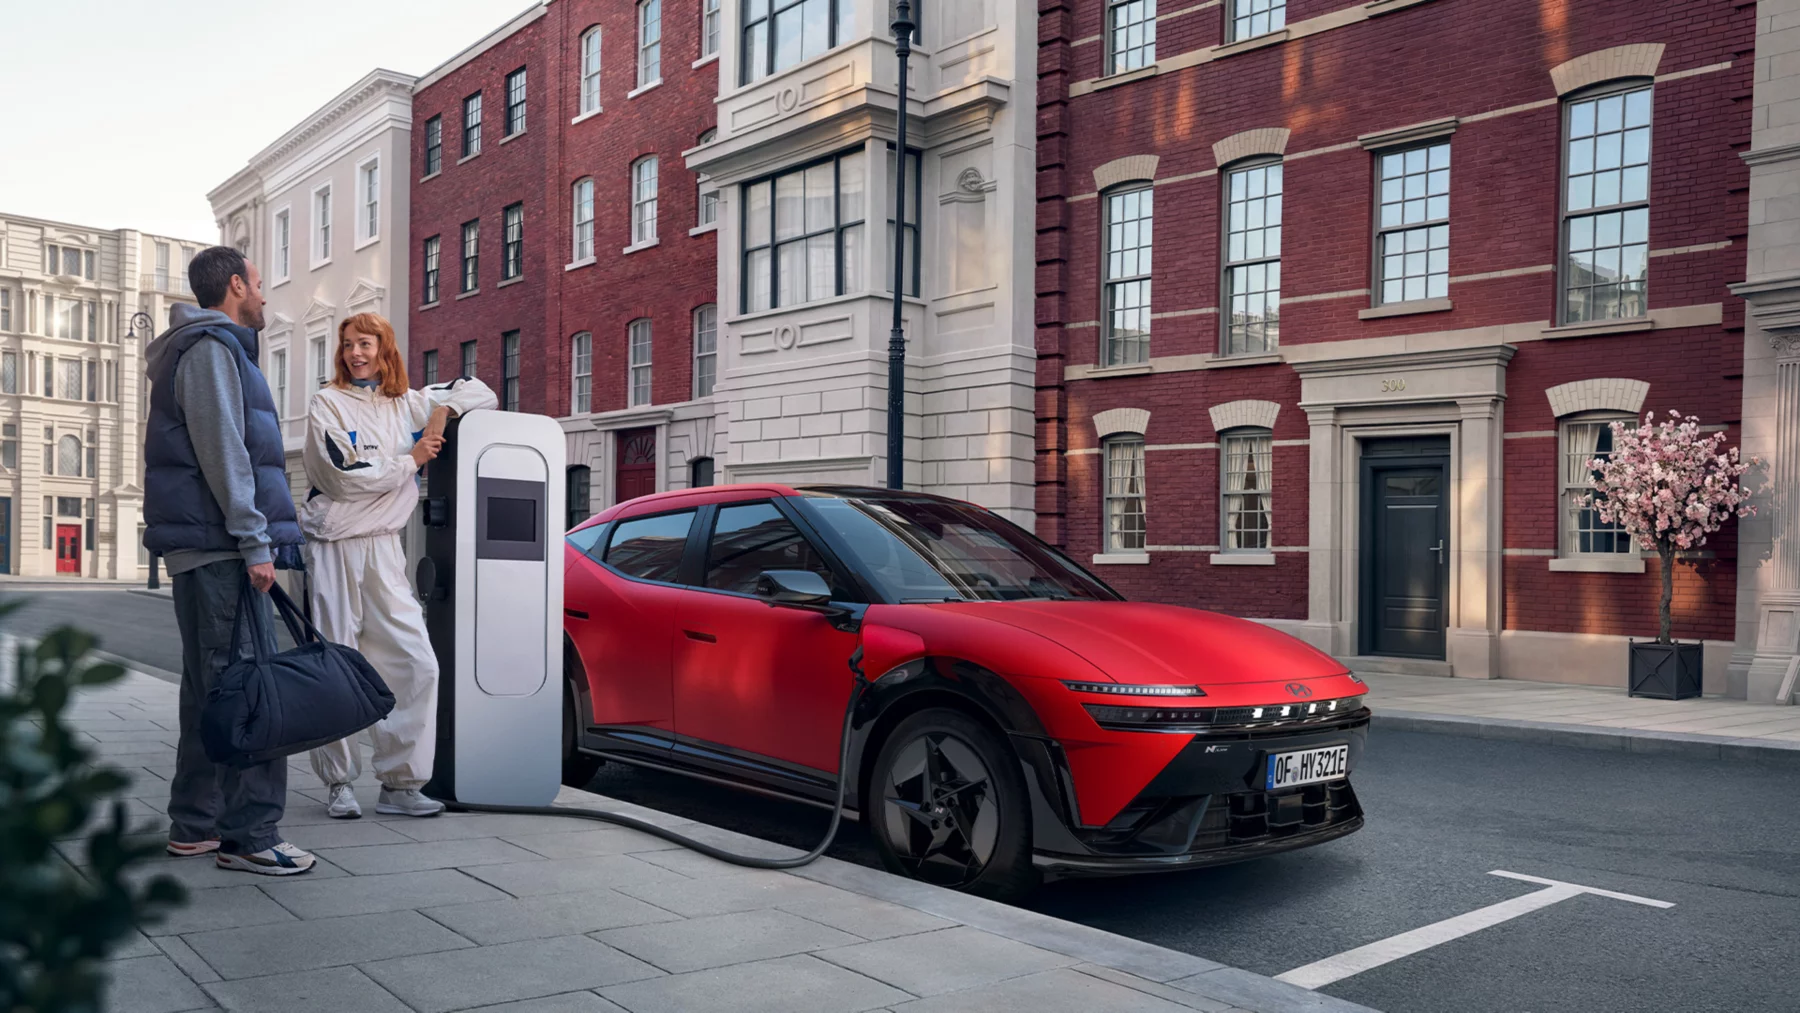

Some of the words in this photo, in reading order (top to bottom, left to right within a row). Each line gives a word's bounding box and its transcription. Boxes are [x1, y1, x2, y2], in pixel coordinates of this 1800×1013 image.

[1381, 379, 1406, 392] 300
[1275, 755, 1293, 784] OF
[1299, 748, 1346, 780] HY321E
